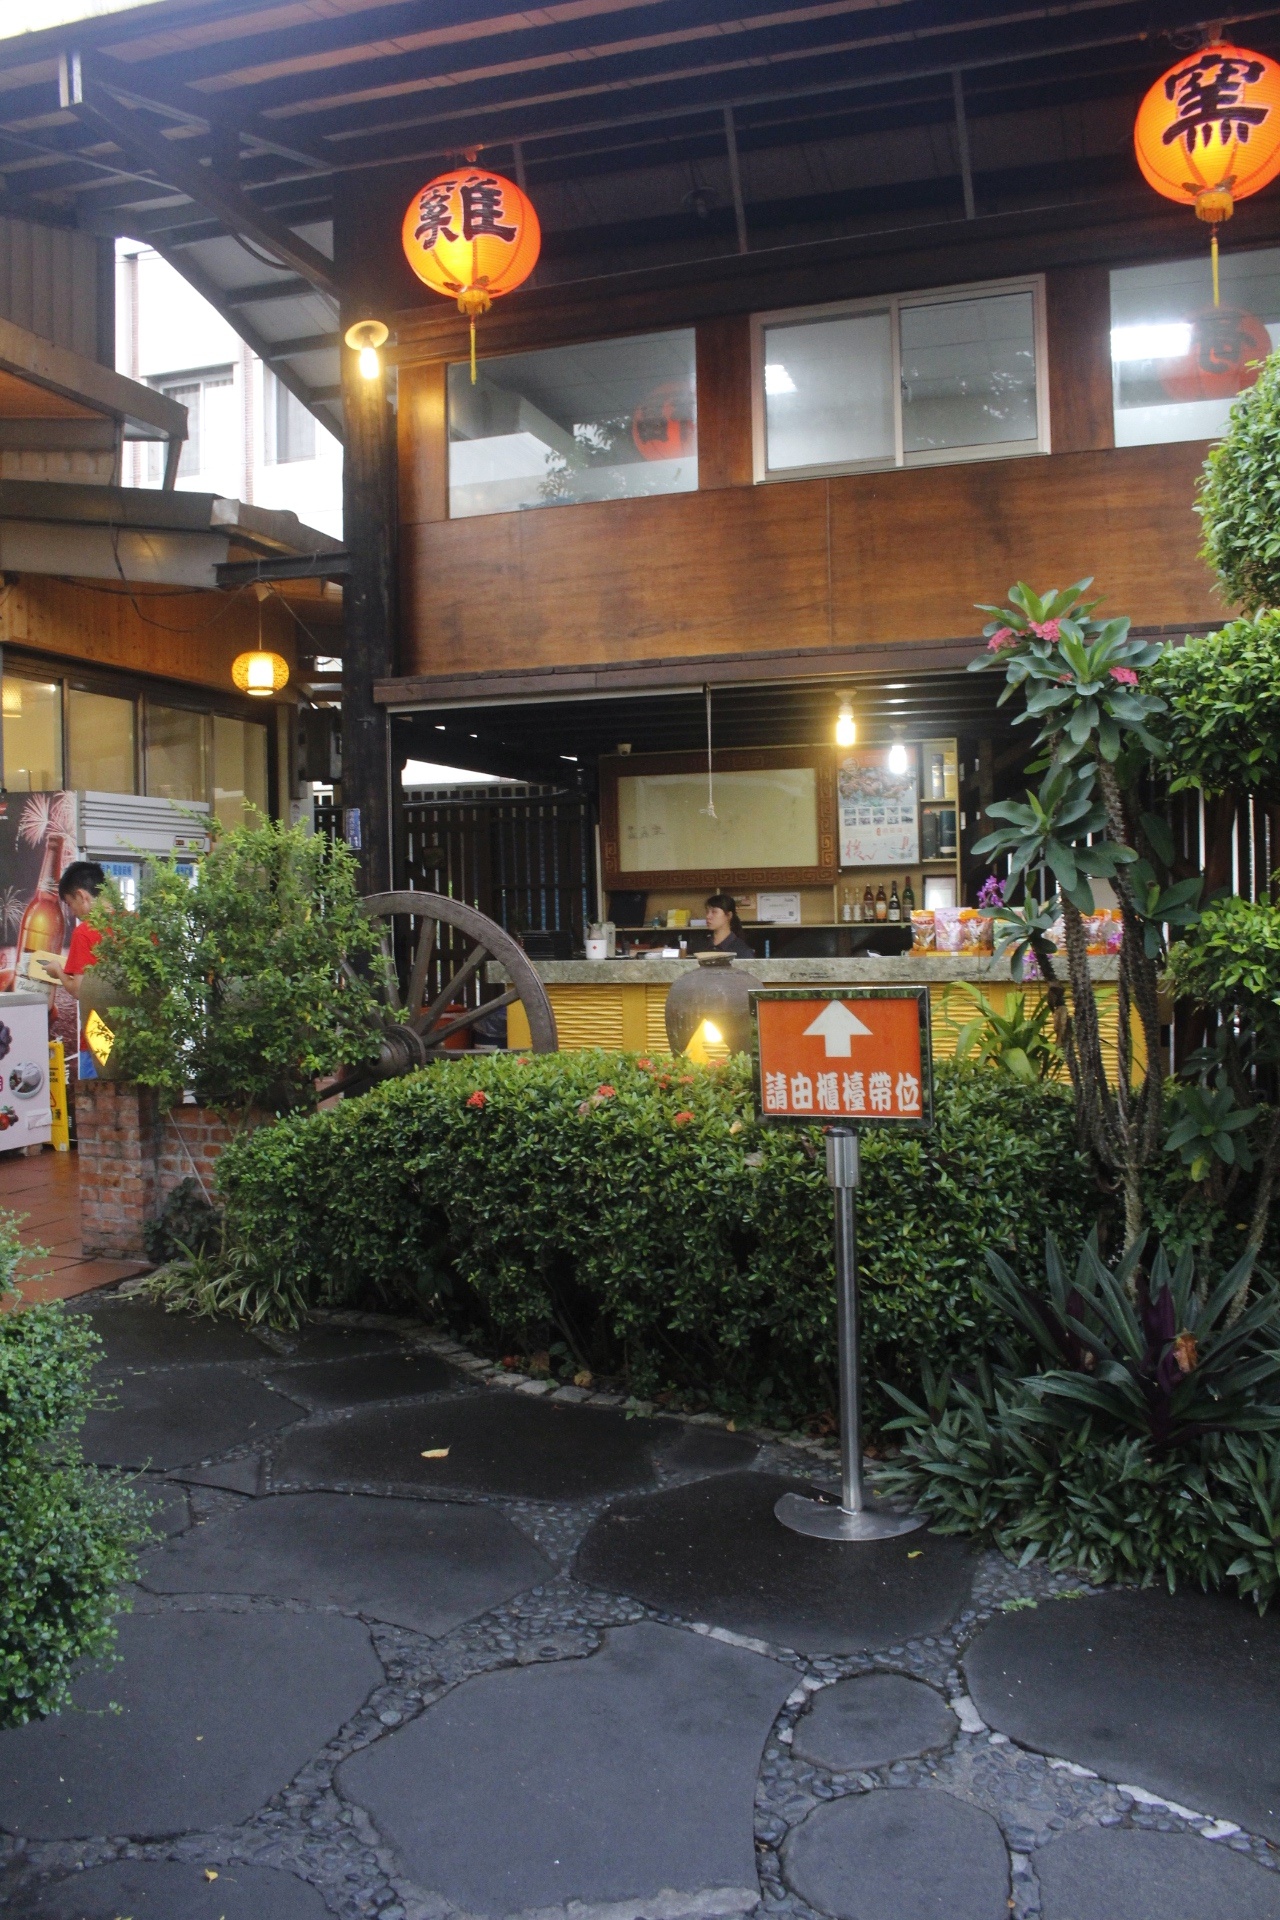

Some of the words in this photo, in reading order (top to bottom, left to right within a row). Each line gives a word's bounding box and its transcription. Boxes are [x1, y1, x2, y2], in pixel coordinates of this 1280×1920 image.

[1162, 54, 1271, 154] 窯
[414, 176, 518, 250] 雞
[765, 1071, 920, 1112] 請由櫃檯帶位
